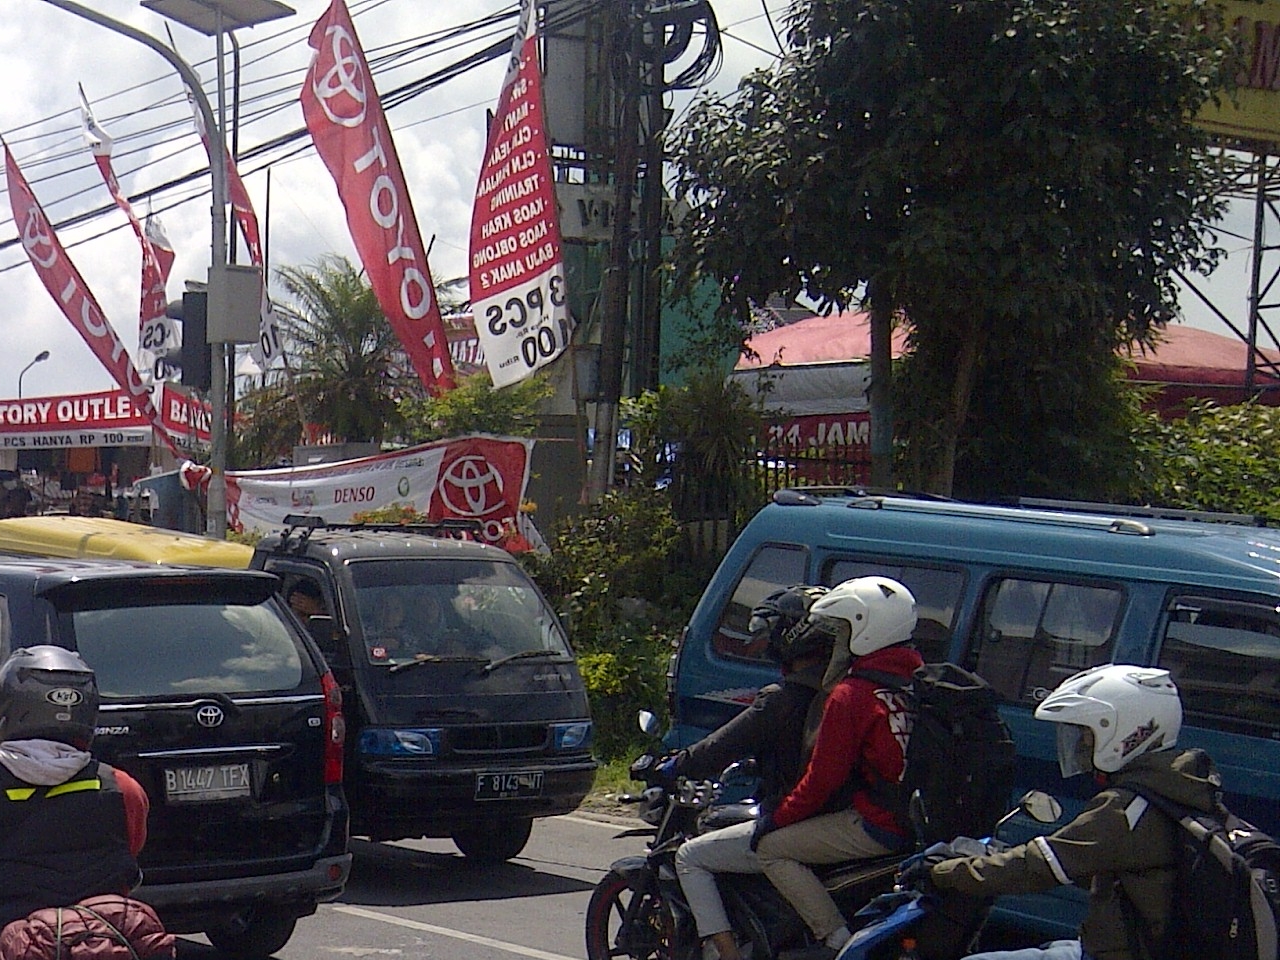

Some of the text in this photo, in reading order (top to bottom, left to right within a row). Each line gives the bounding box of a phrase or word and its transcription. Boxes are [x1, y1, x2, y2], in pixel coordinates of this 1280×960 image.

[4, 437, 26, 447] PCS
[33, 435, 73, 446] HANYA
[80, 434, 95, 444] RP
[103, 433, 124, 444] 100
[808, 421, 870, 446] JAM
[334, 486, 376, 504] DENSO
[164, 763, 249, 790] B 1447 TFX
[477, 776, 485, 792] F
